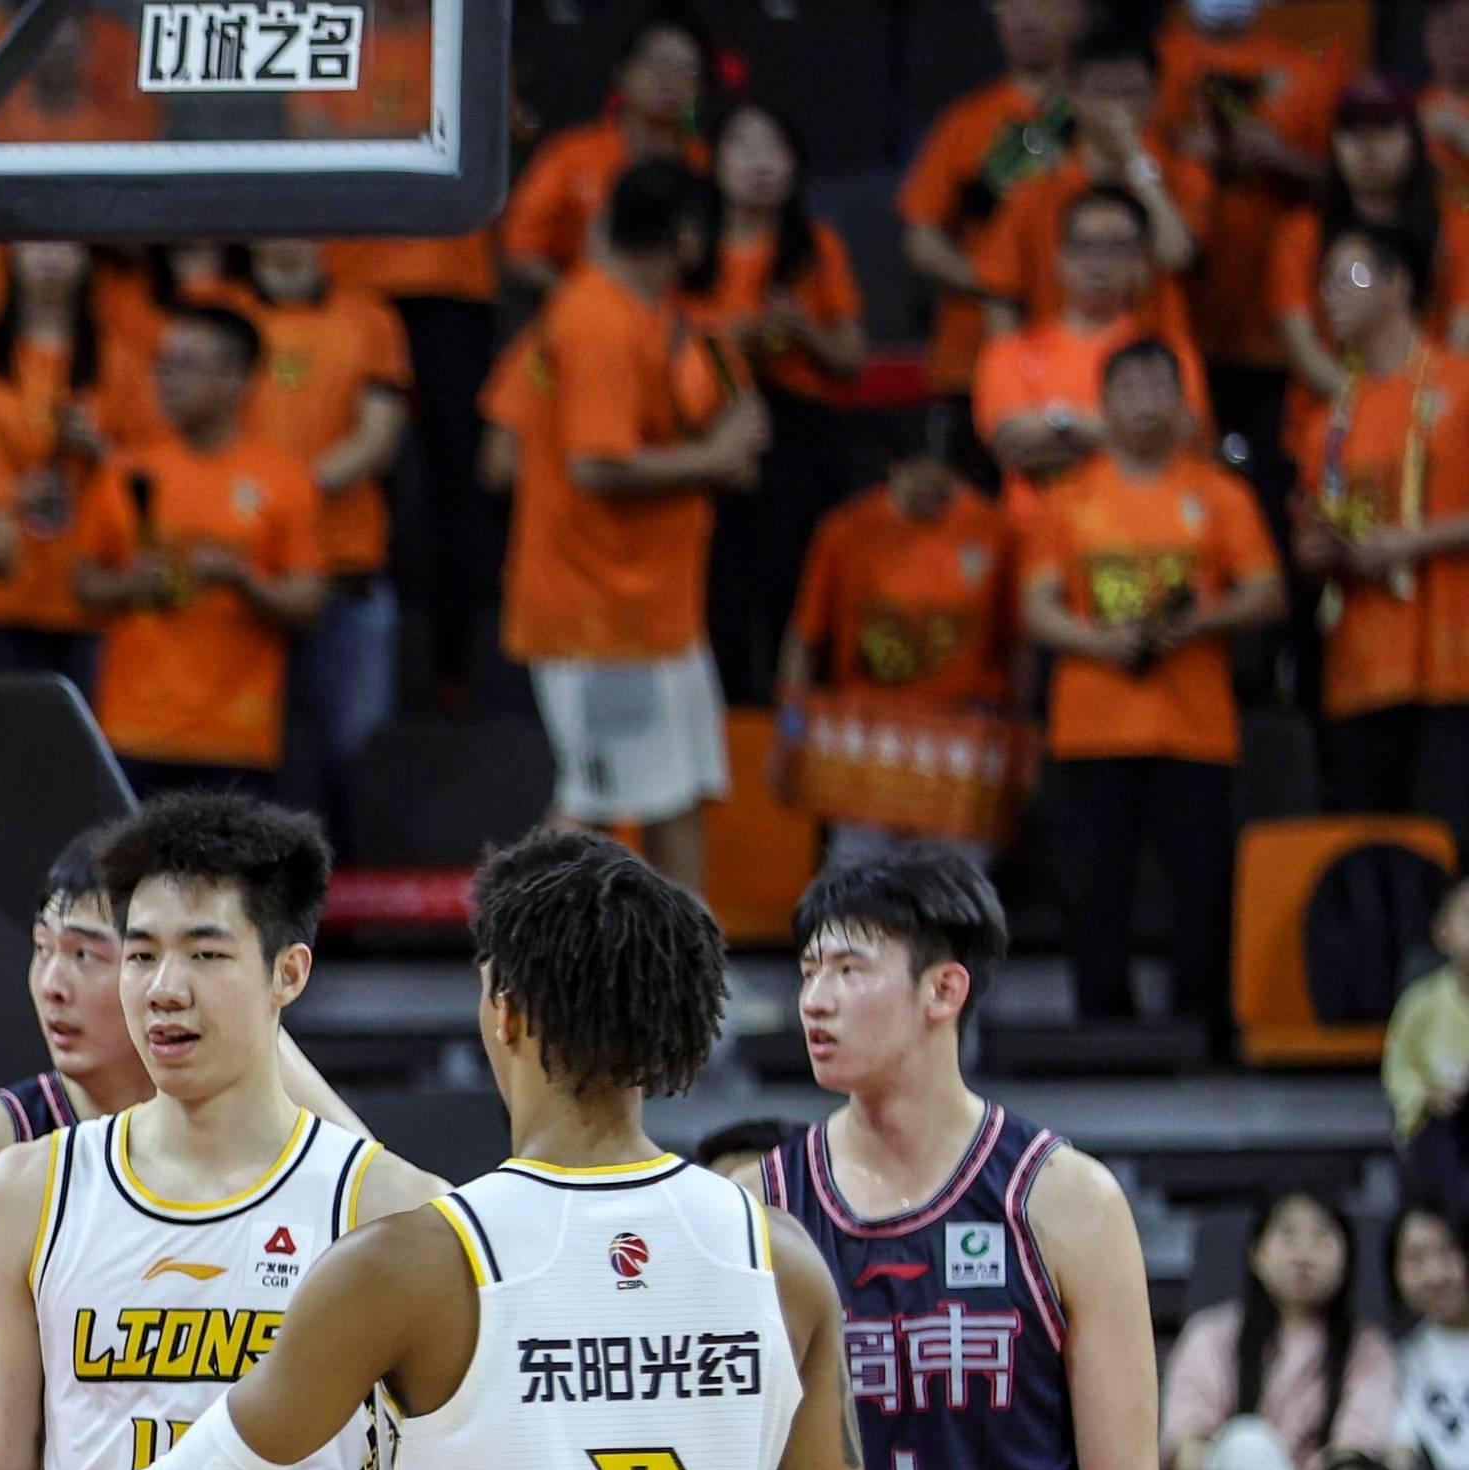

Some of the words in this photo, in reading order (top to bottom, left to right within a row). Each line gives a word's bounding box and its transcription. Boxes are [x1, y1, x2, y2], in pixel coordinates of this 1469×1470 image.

[145, 5, 358, 85] 以城之名
[518, 1330, 761, 1403] 东阳光药
